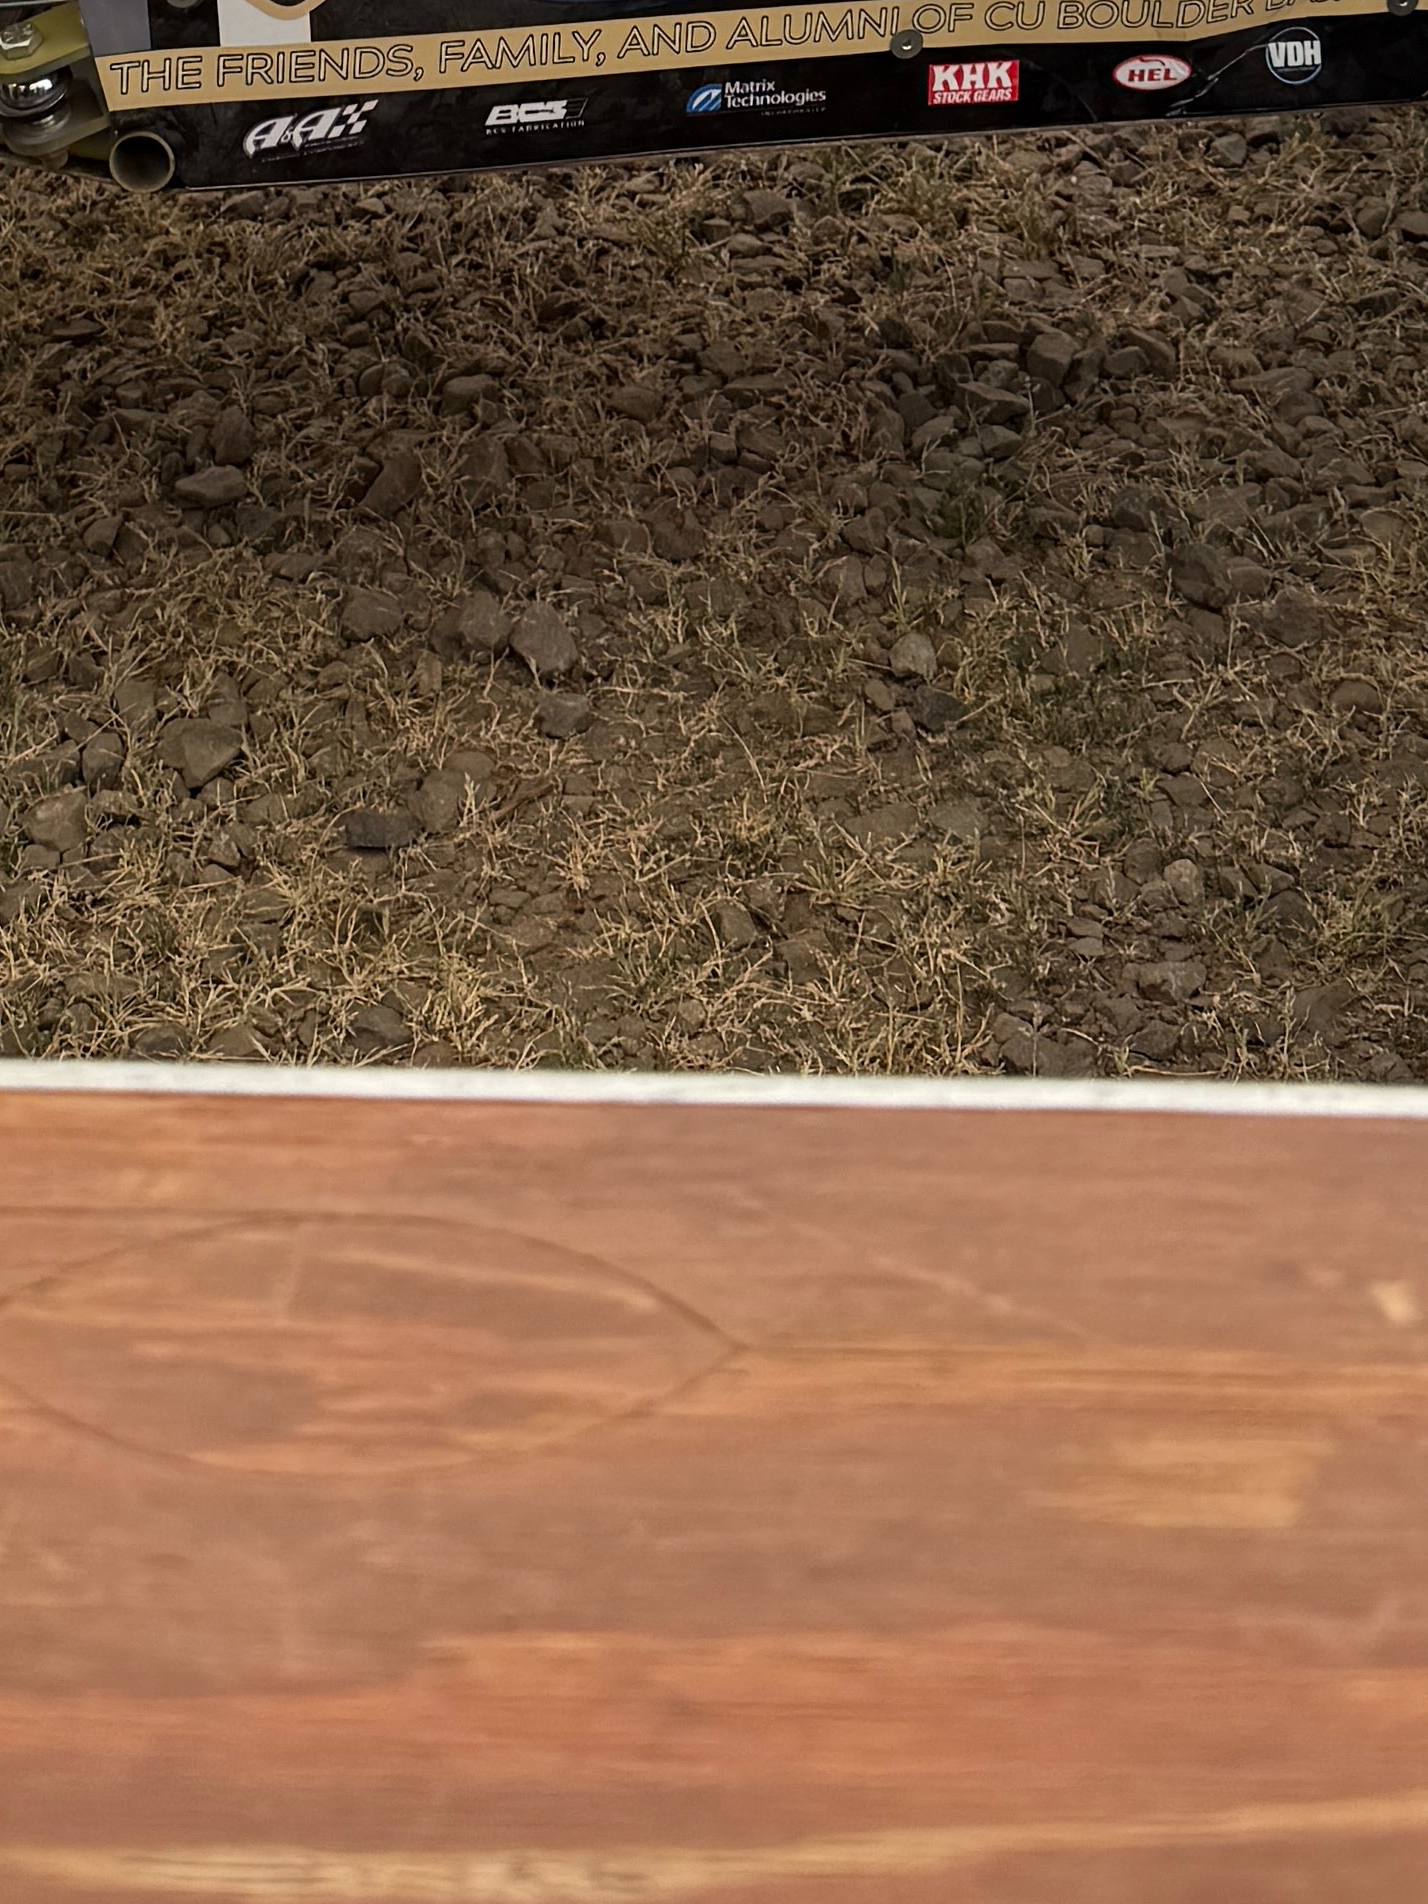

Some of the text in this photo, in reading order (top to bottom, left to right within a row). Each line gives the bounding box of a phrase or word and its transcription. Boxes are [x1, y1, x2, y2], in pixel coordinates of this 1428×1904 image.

[109, 55, 202, 94] THE
[216, 42, 424, 88] FRIENDS,
[438, 27, 606, 73] FAMILY,
[619, 18, 715, 59] AND
[727, 8, 903, 50] ALUMNI
[911, 0, 974, 35] OF
[982, 0, 1047, 32] CU
[1269, 39, 1321, 68] VDH
[931, 61, 1011, 92] KHK
[1127, 67, 1177, 83] HEL
[725, 78, 775, 94] Matrix
[724, 90, 827, 108] Technologies
[933, 88, 1012, 104] STOCK GEARS
